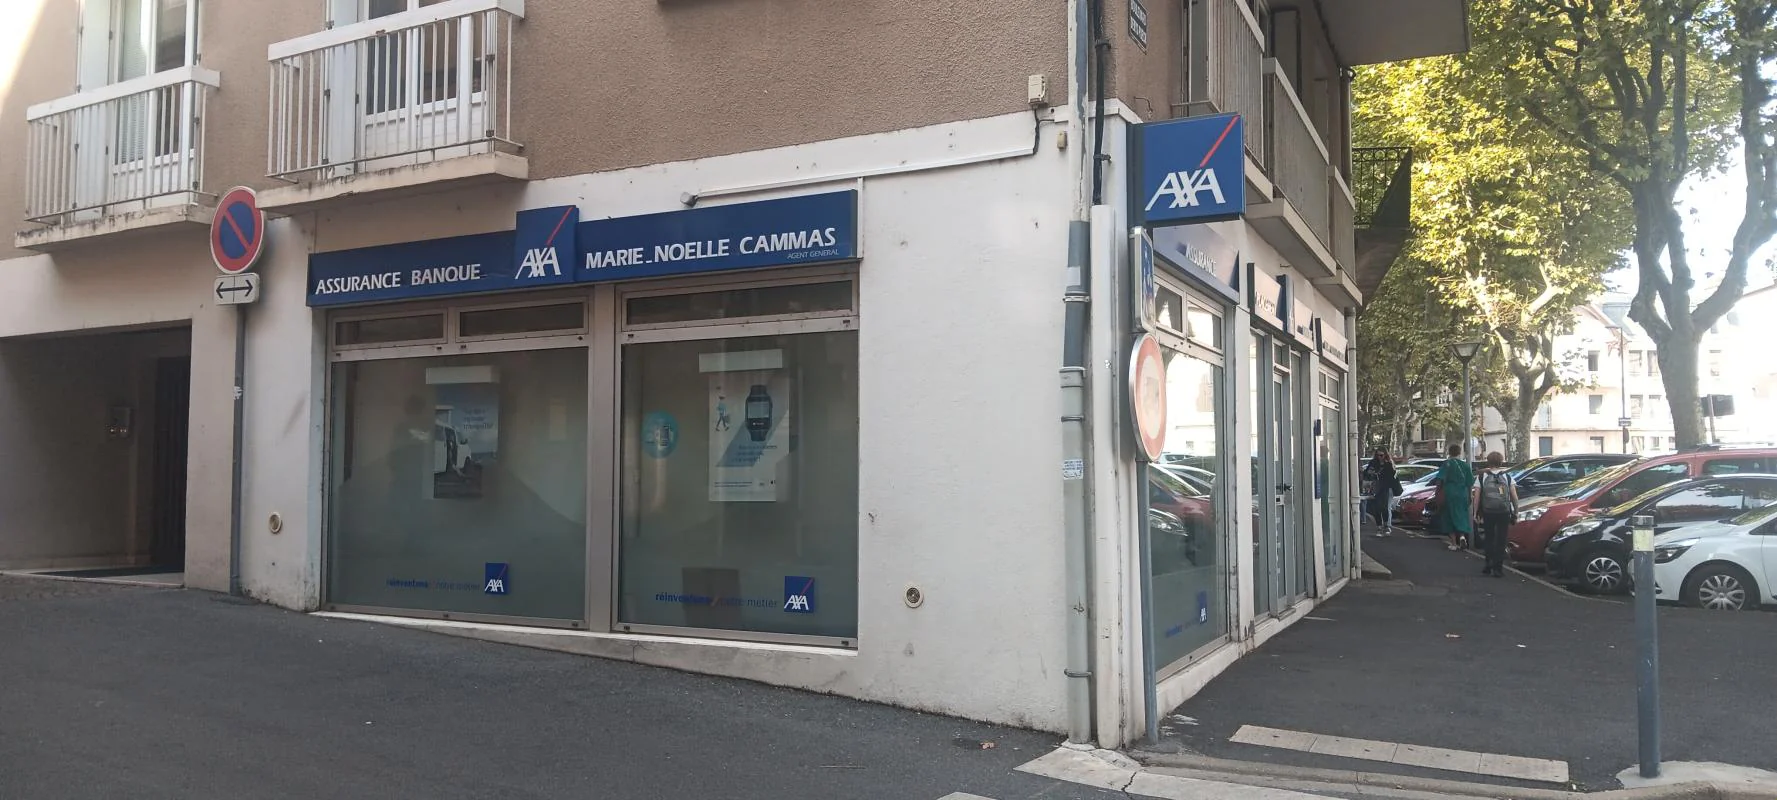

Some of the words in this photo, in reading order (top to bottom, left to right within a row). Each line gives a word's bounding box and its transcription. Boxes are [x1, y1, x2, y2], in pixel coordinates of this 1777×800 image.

[1145, 167, 1226, 212] AXA
[739, 227, 836, 255] CAMMAS
[514, 246, 561, 280] AXA
[787, 251, 809, 260] AGENT
[315, 271, 401, 295] ASSURANCE
[411, 263, 481, 286] BANQUE
[484, 579, 504, 593] AXA
[783, 594, 810, 611] AXA
